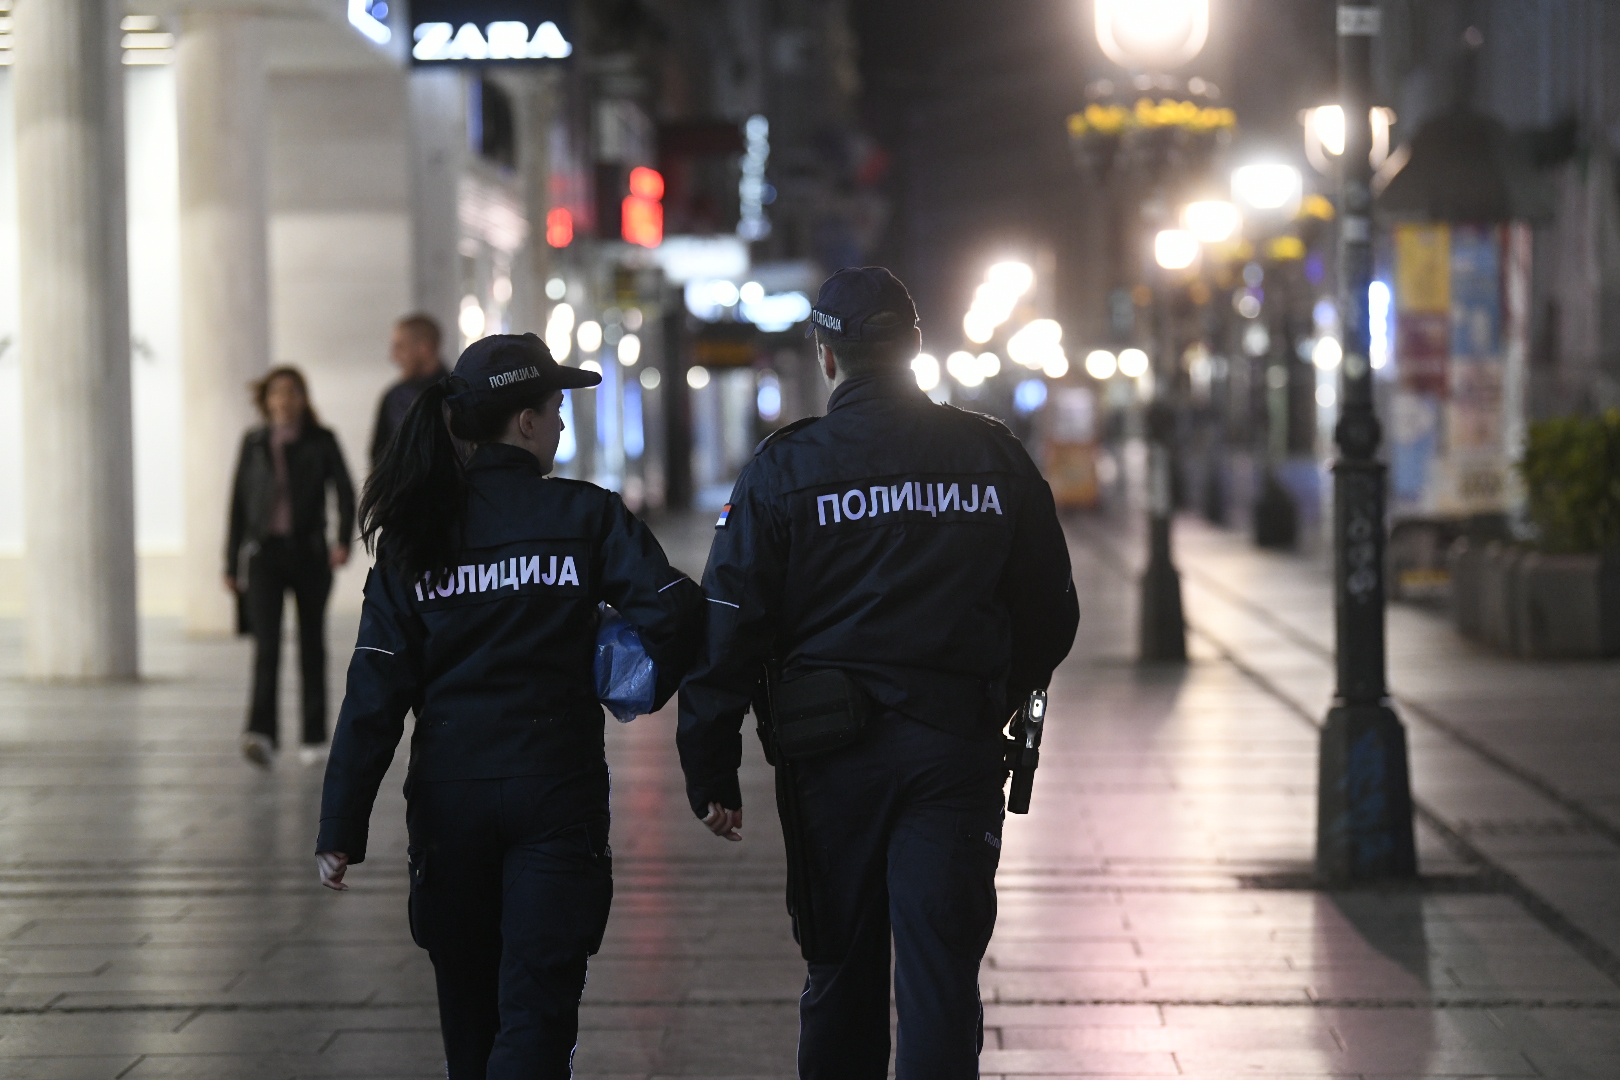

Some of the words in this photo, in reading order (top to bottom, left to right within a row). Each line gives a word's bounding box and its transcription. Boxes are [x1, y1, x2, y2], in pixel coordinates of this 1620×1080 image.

[412, 20, 573, 61] ZARA
[488, 366, 540, 389] ПОЛИЦИЈА
[817, 481, 1003, 526] ПОЛИЦИЈА
